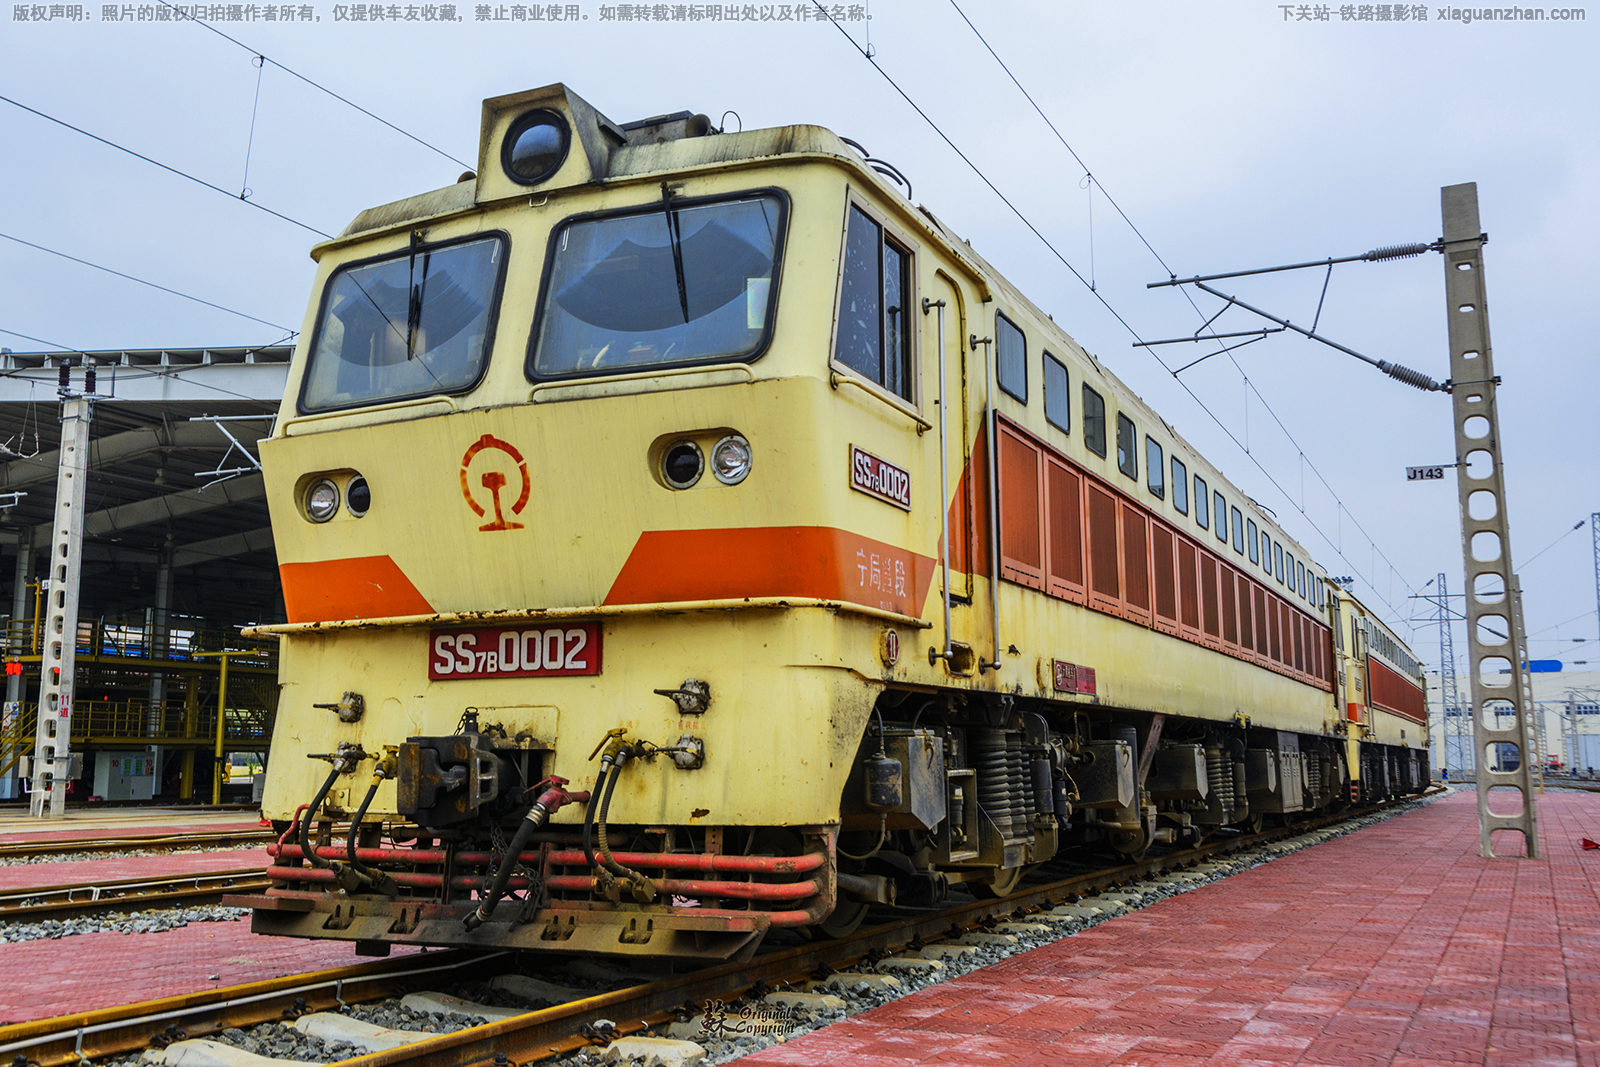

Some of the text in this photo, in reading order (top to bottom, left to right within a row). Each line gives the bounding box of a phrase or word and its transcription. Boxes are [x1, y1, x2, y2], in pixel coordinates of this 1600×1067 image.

[855, 451, 909, 505] SS7B0002
[1407, 467, 1443, 480] J143
[434, 628, 588, 674] SS7B0002
[60, 694, 70, 706] 11
